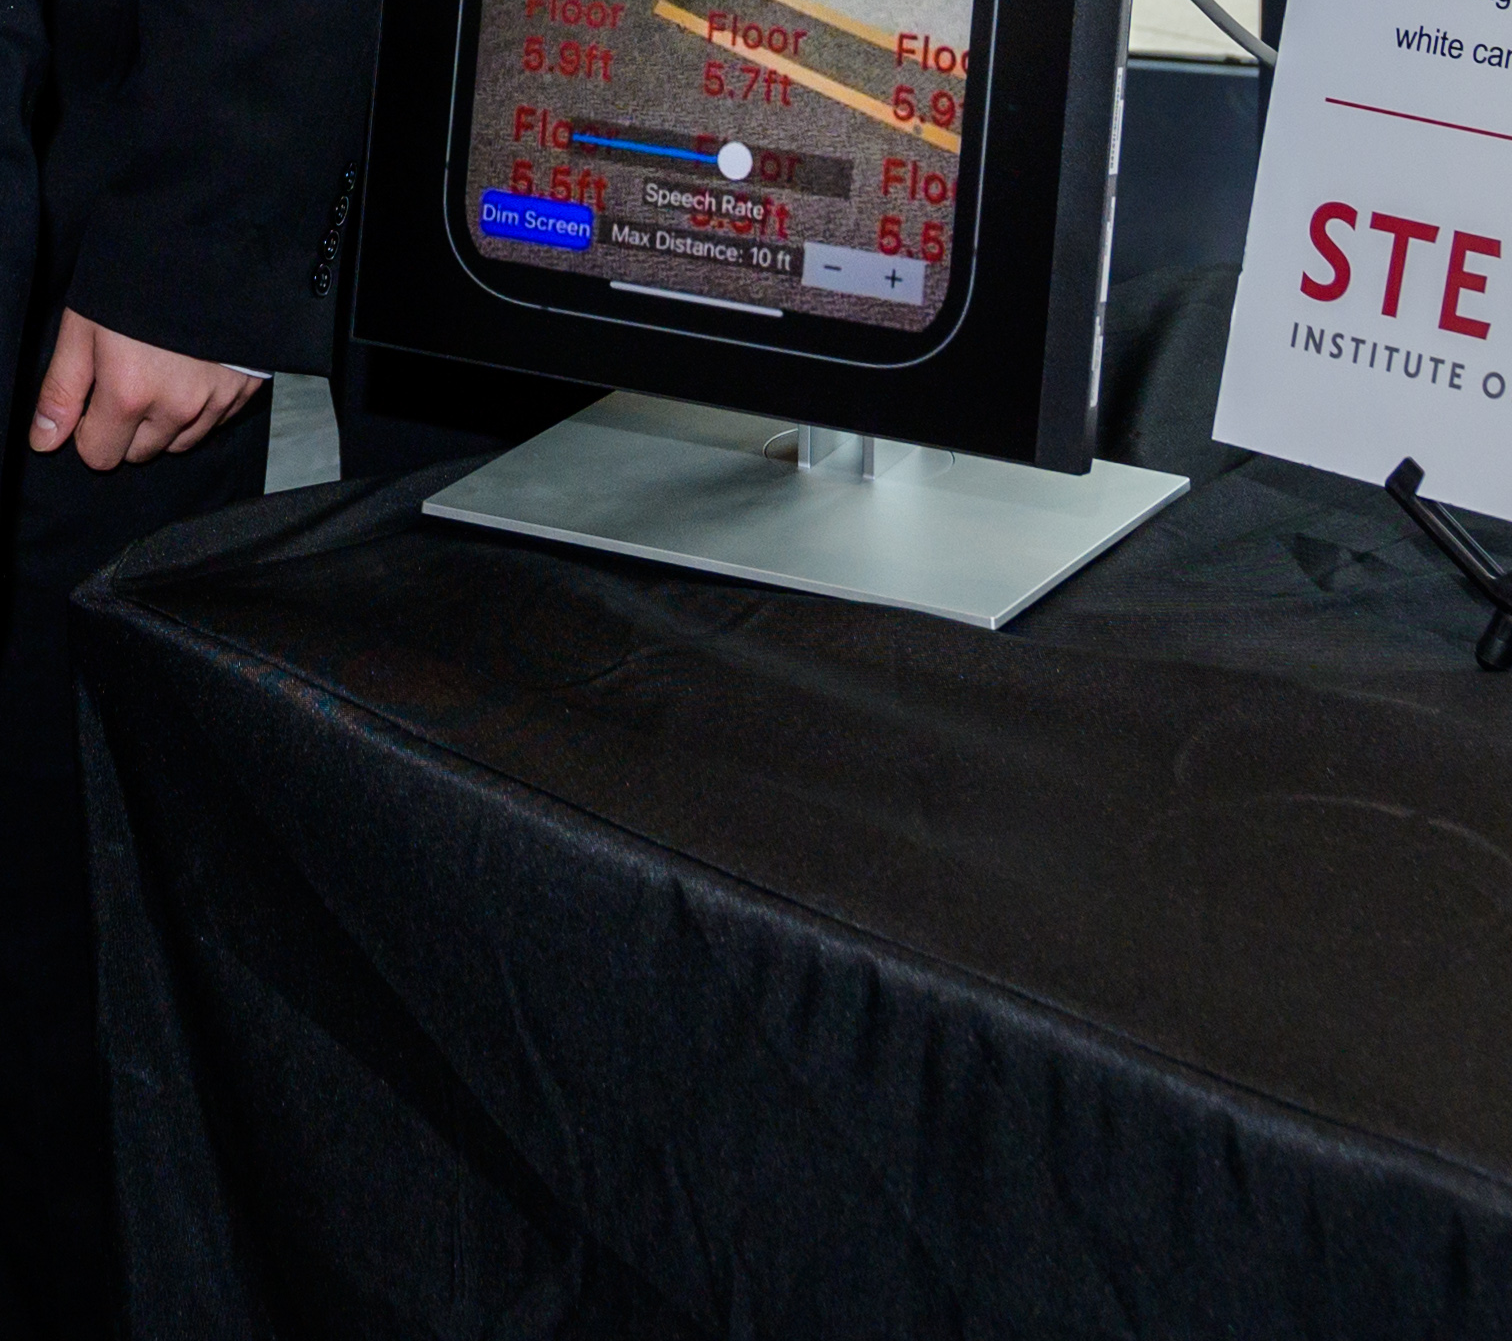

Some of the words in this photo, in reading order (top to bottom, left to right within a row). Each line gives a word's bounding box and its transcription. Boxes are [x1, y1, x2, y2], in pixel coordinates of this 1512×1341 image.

[706, 10, 808, 58] Floor
[522, 35, 615, 83] 5.9ft
[702, 61, 792, 108] 5.7ft
[482, 204, 520, 229] Dim
[524, 209, 592, 239] Screen
[644, 183, 717, 215] Speech
[720, 193, 766, 221] Rate
[612, 226, 651, 248] Max
[655, 231, 744, 265] Distance:
[751, 246, 772, 269] 10
[777, 249, 792, 273] ft
[1289, 321, 1466, 391] INSTITUTE
